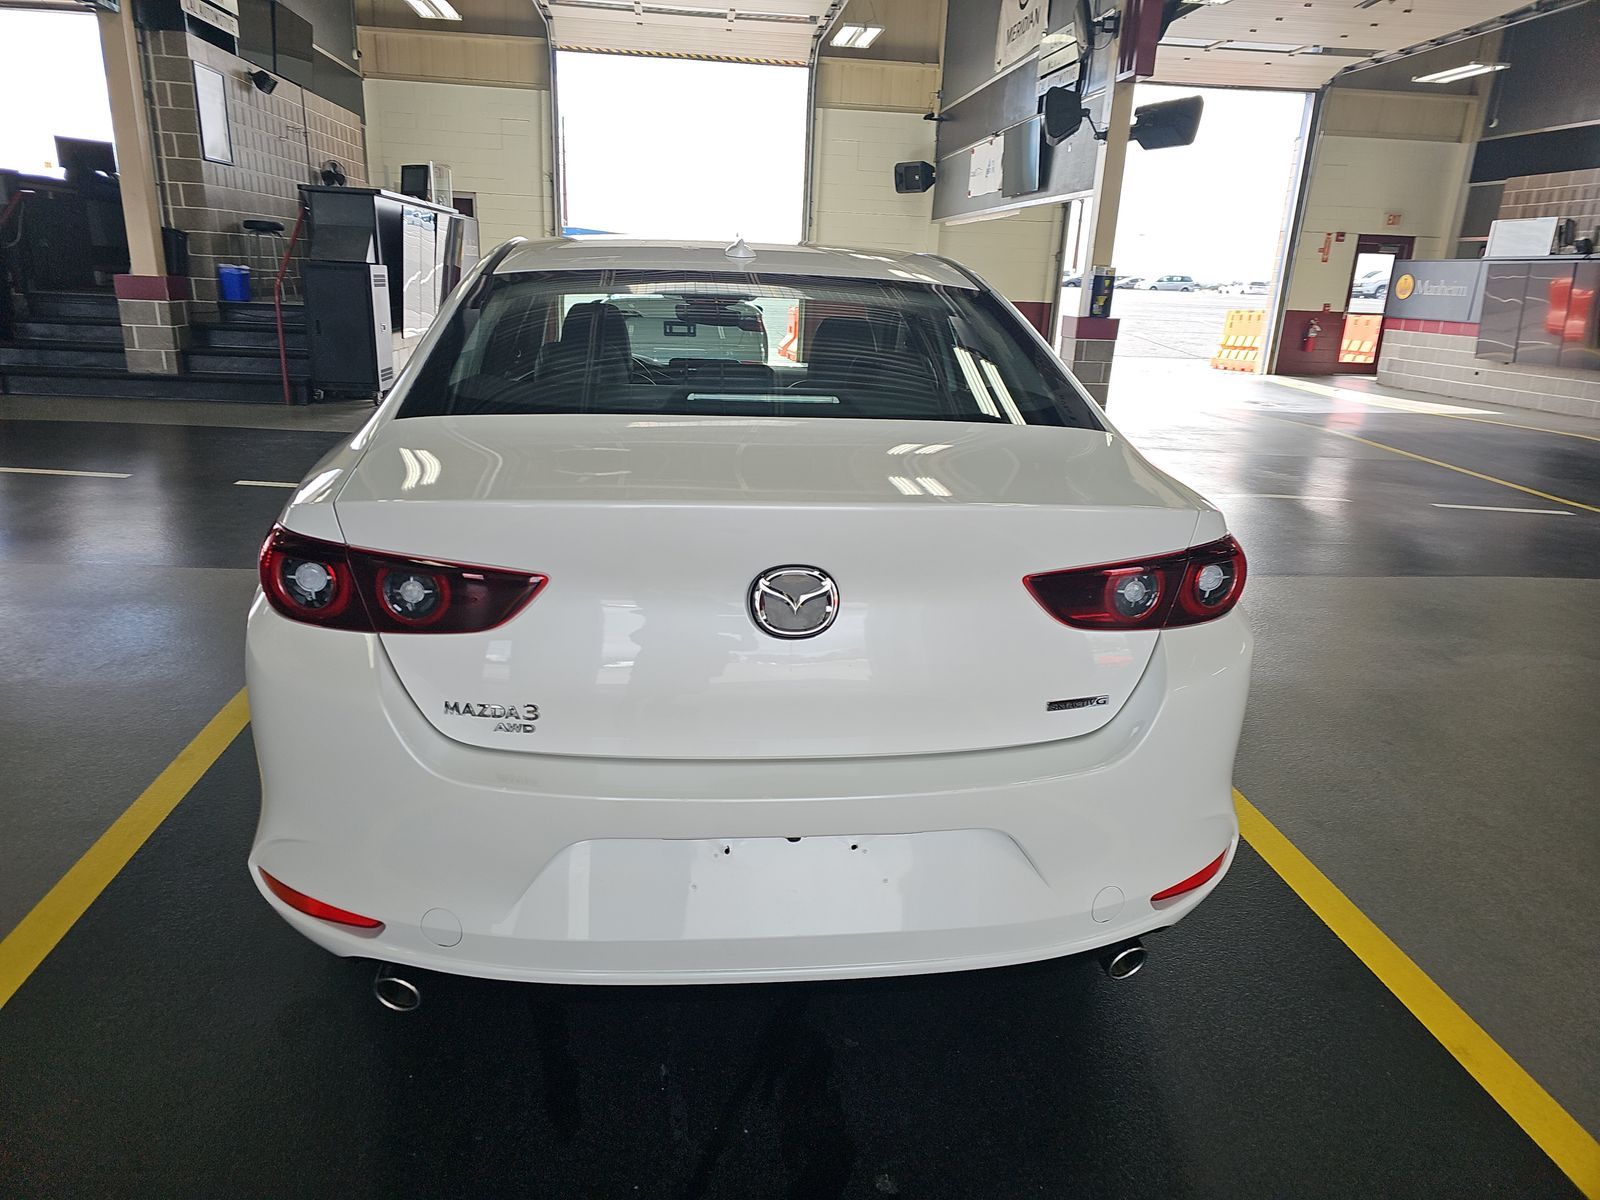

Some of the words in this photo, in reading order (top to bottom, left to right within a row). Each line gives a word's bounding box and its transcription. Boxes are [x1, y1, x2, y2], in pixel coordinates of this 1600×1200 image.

[1007, 6, 1040, 44] MERIDIAN
[1413, 280, 1468, 296] Manheim
[493, 722, 537, 734] AWD
